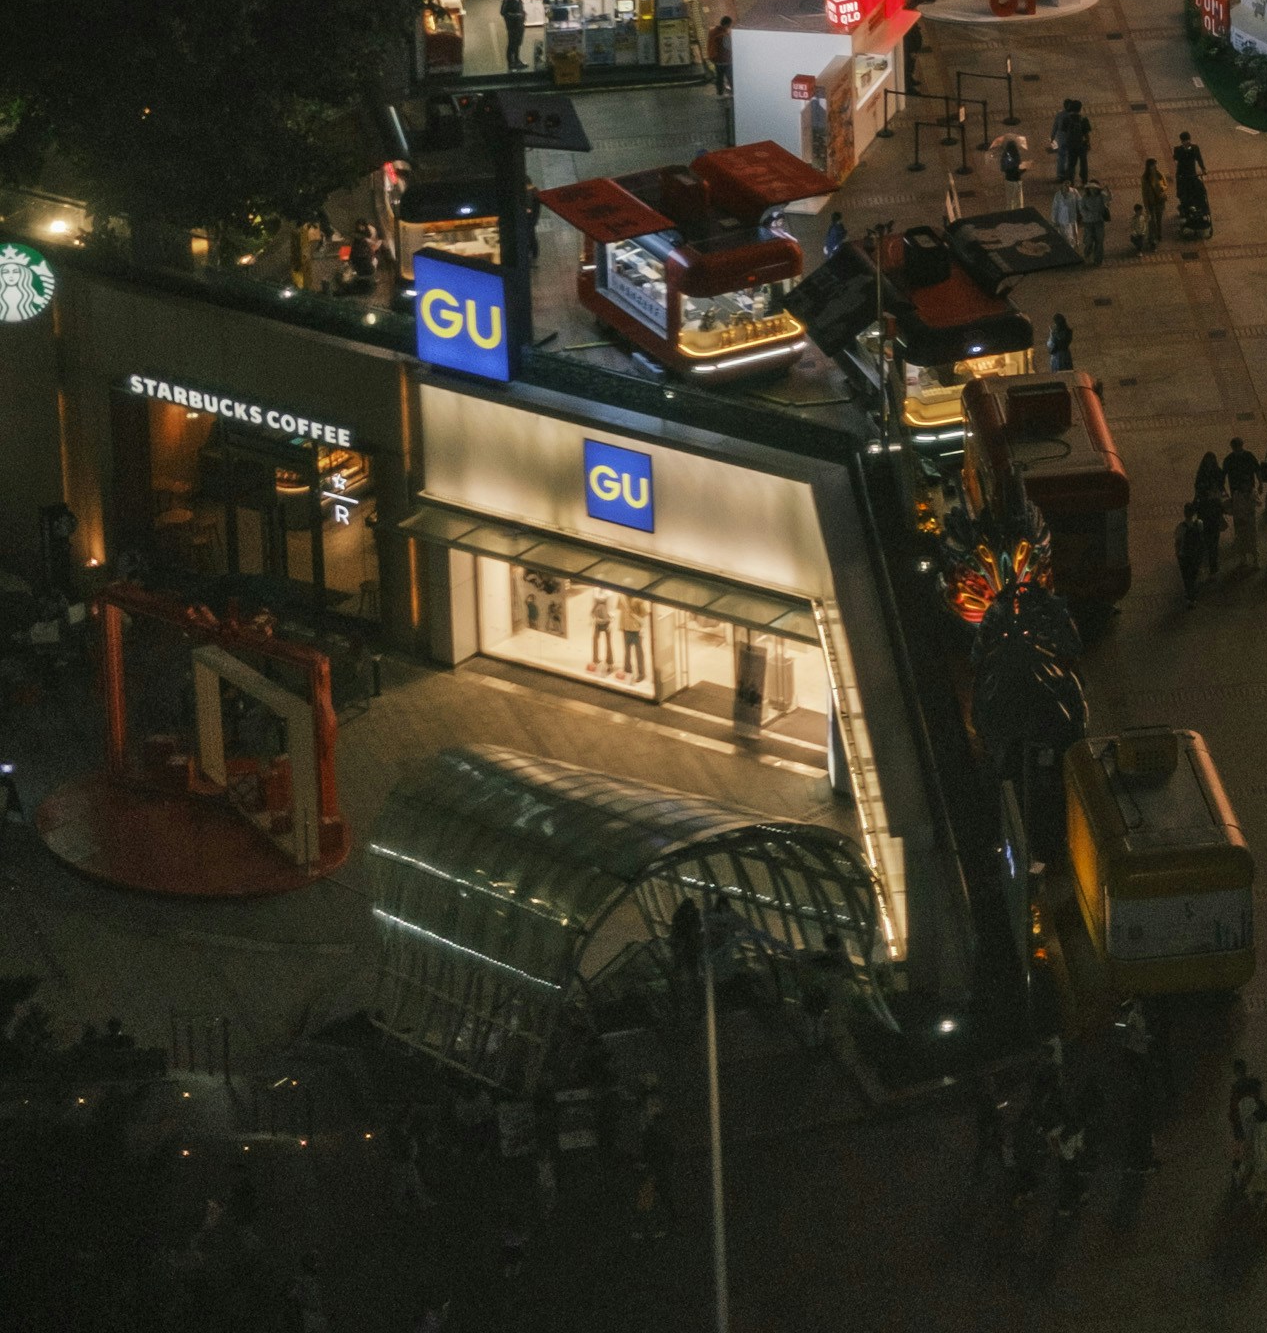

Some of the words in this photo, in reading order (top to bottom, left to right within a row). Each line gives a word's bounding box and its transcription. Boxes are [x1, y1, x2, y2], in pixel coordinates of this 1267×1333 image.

[839, 1, 858, 14] UNI
[840, 11, 861, 25] QLO
[420, 288, 502, 350] GU
[130, 374, 263, 424] STARBUCKS
[266, 410, 351, 448] COFFEE
[589, 464, 649, 509] GU
[334, 503, 350, 526] R
